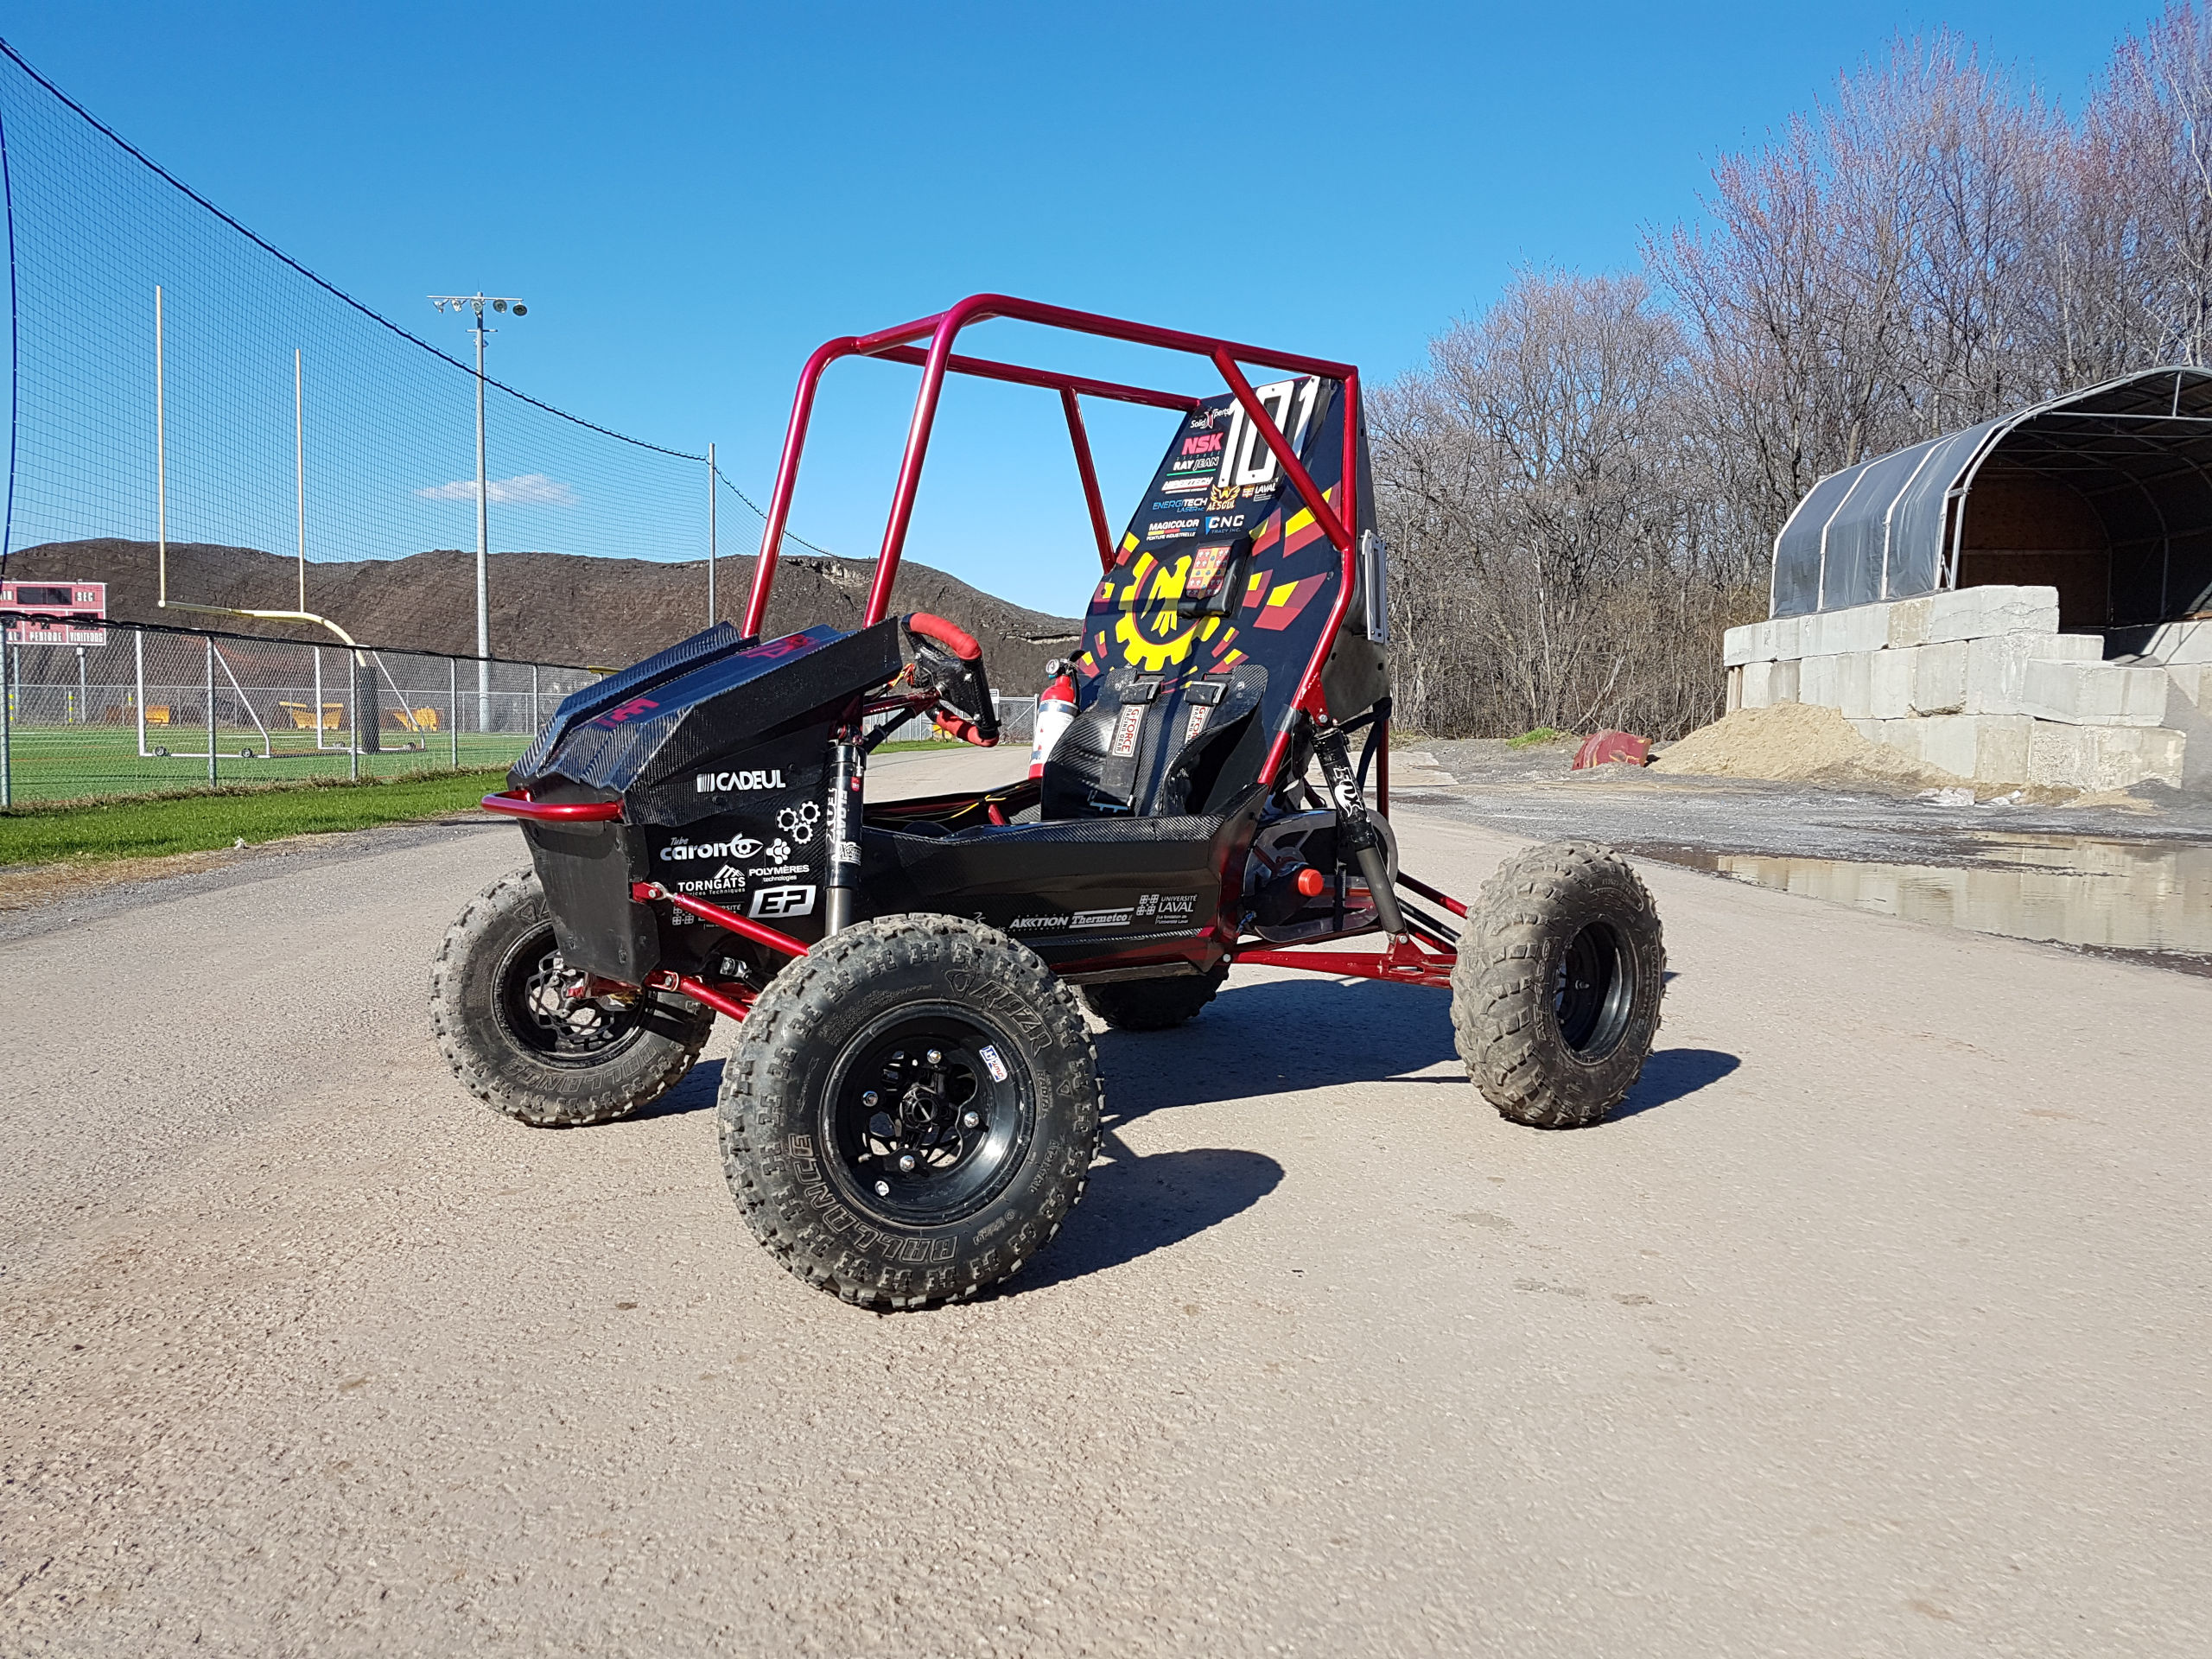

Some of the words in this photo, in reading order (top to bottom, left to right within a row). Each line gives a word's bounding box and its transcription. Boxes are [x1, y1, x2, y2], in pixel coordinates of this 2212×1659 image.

[1217, 376, 1320, 488] 101
[1182, 432, 1224, 454] NSK
[1173, 460, 1194, 470] RAY
[1255, 482, 1275, 493] LAVAL
[1149, 518, 1199, 531] MAGICOLOR
[1209, 514, 1244, 528] CNC
[77, 592, 93, 601] SEC
[715, 769, 786, 791] CADEUL
[1333, 767, 1364, 812] FOX
[671, 836, 690, 846] Tube
[748, 864, 810, 877] POLYMÈRES
[678, 877, 746, 893] TORNGATS
[762, 874, 798, 883] technologies
[709, 887, 746, 896] Techniques
[1160, 893, 1198, 902] UNIVERSITÉ
[1158, 901, 1194, 912] LAVAL
[969, 980, 1054, 1058] RAZR
[788, 1134, 960, 1263] BALLANCE
